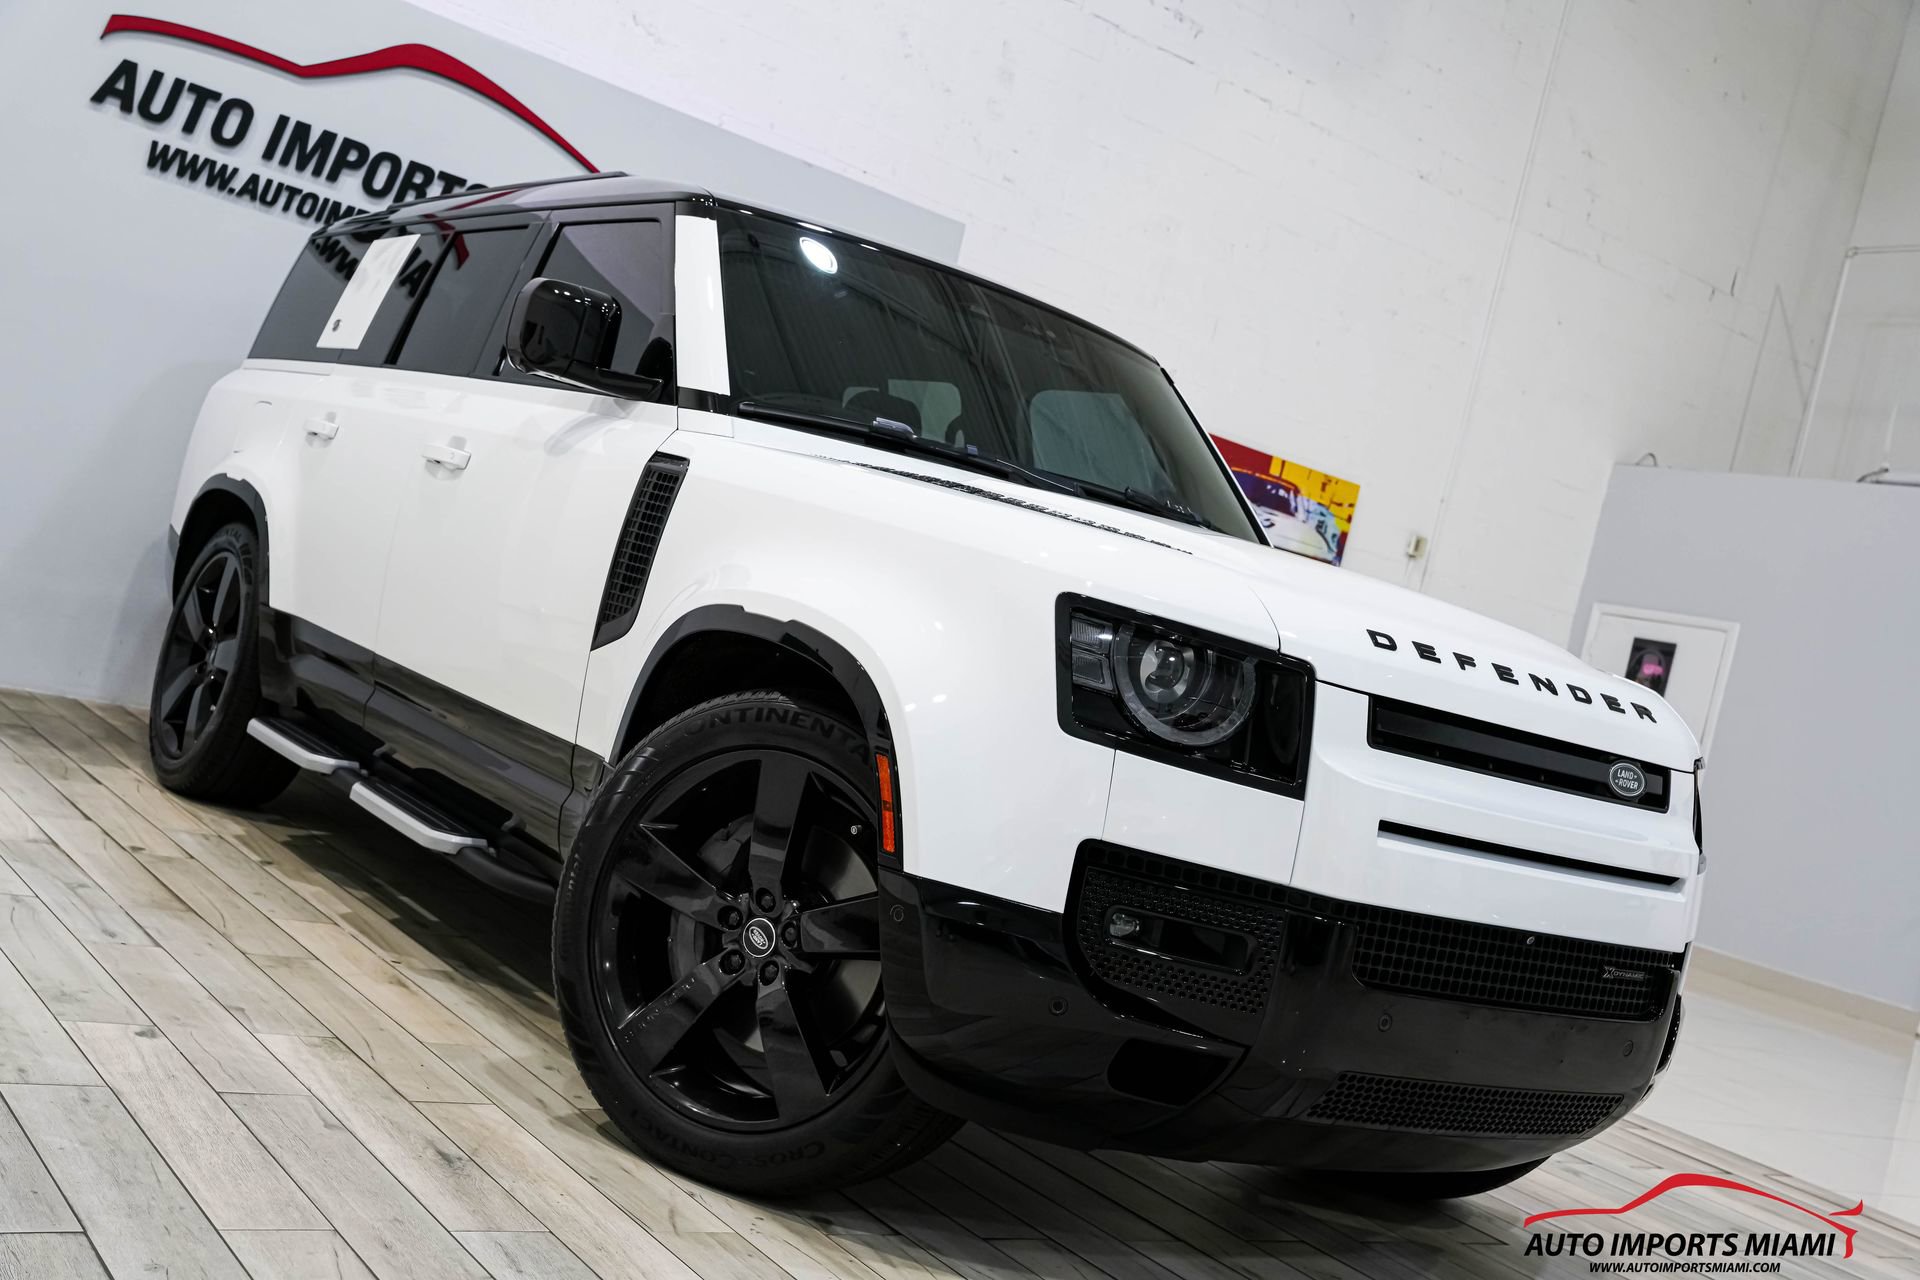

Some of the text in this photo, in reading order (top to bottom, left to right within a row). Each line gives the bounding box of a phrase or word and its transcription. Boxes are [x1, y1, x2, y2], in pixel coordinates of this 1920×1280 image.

[90, 58, 489, 203] AUTO IMPORT
[147, 140, 371, 224] WWW.AUTOIM
[1366, 629, 1658, 723] DEFENDER
[1617, 769, 1634, 780] LAND
[1618, 778, 1639, 790] ROVER
